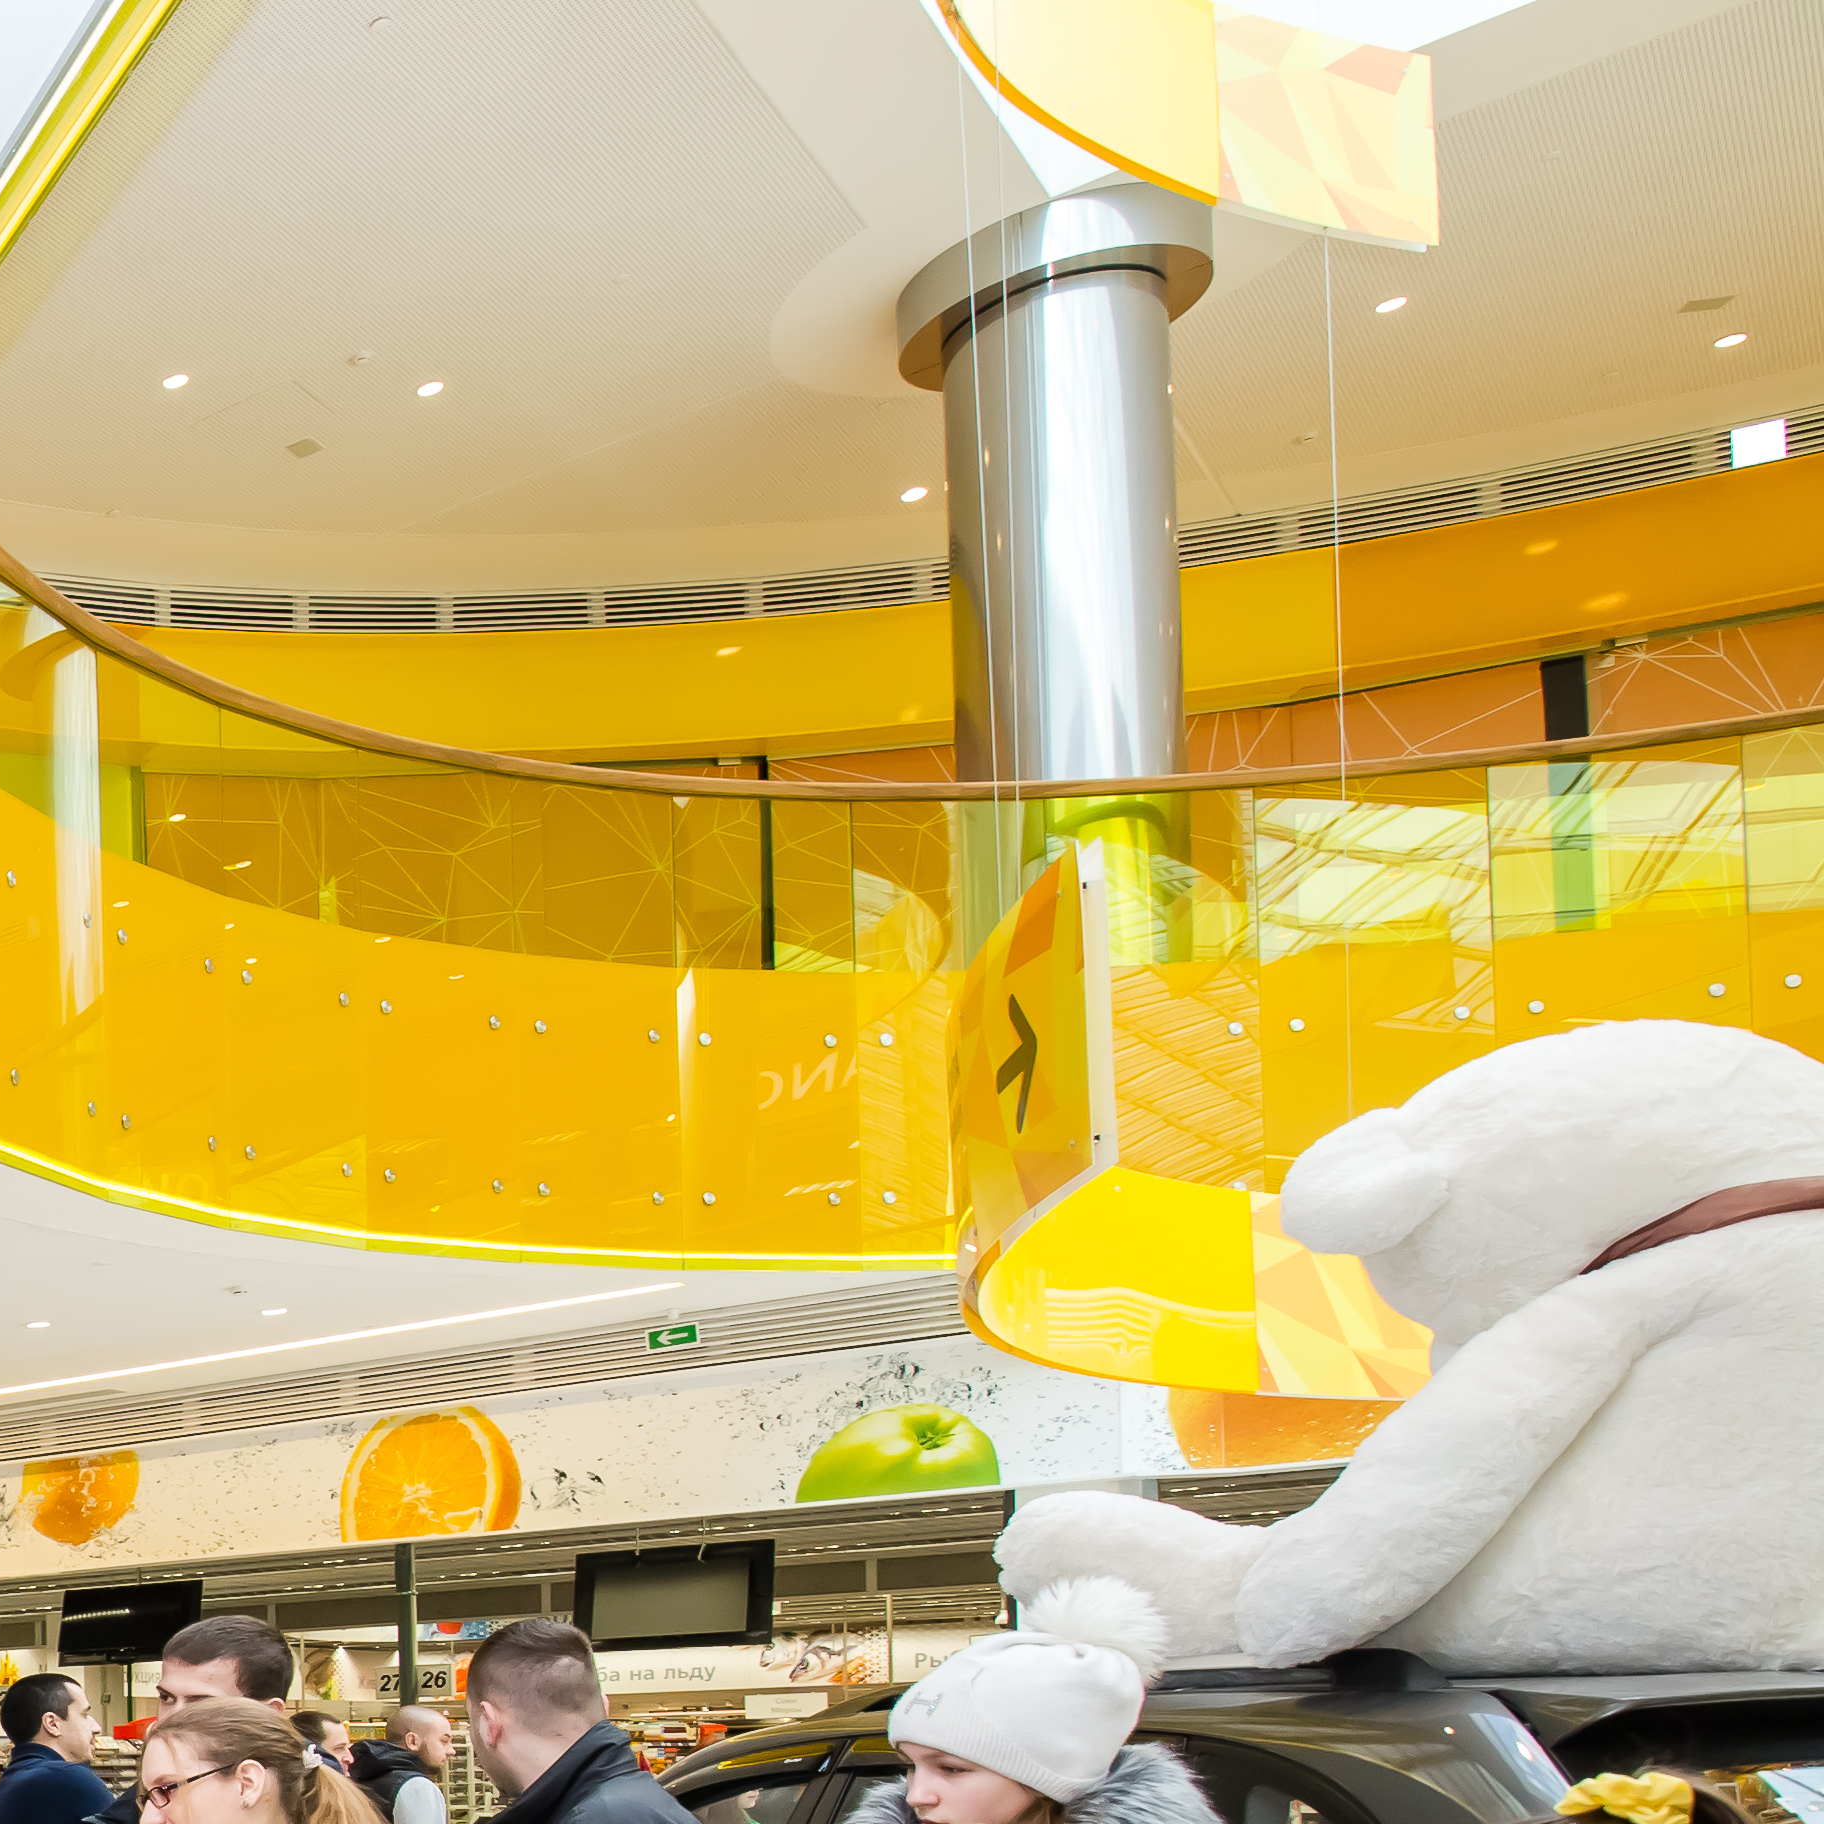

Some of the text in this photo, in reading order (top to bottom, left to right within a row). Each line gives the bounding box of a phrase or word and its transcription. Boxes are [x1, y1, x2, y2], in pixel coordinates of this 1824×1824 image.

[421, 1670, 448, 1689] 26
[630, 1668, 657, 1682] на
[664, 1664, 716, 1684] льду
